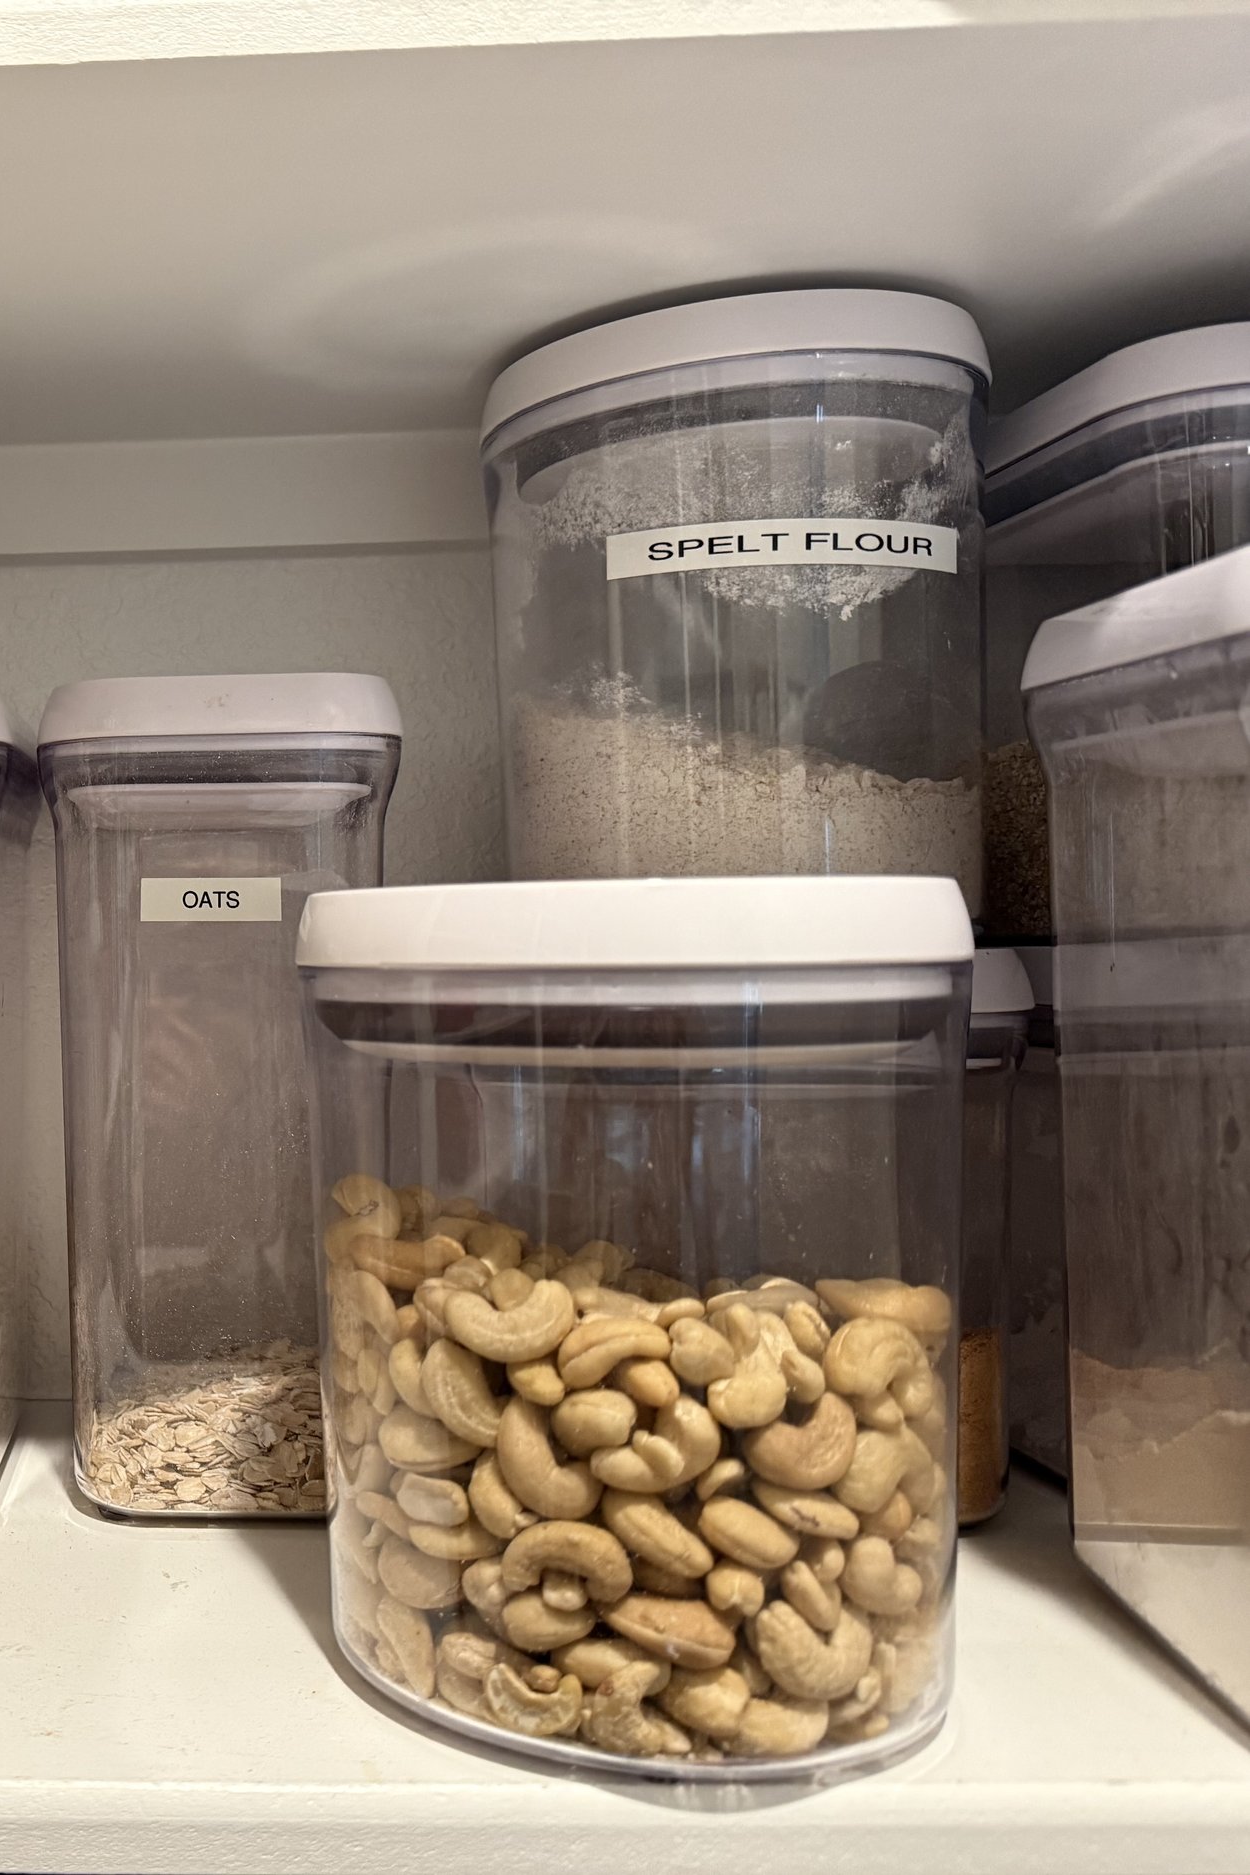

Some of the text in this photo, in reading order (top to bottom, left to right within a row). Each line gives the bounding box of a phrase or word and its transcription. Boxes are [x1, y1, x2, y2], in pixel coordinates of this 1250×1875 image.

[647, 532, 933, 561] SPELT FLOUR
[182, 890, 240, 908] OATS
